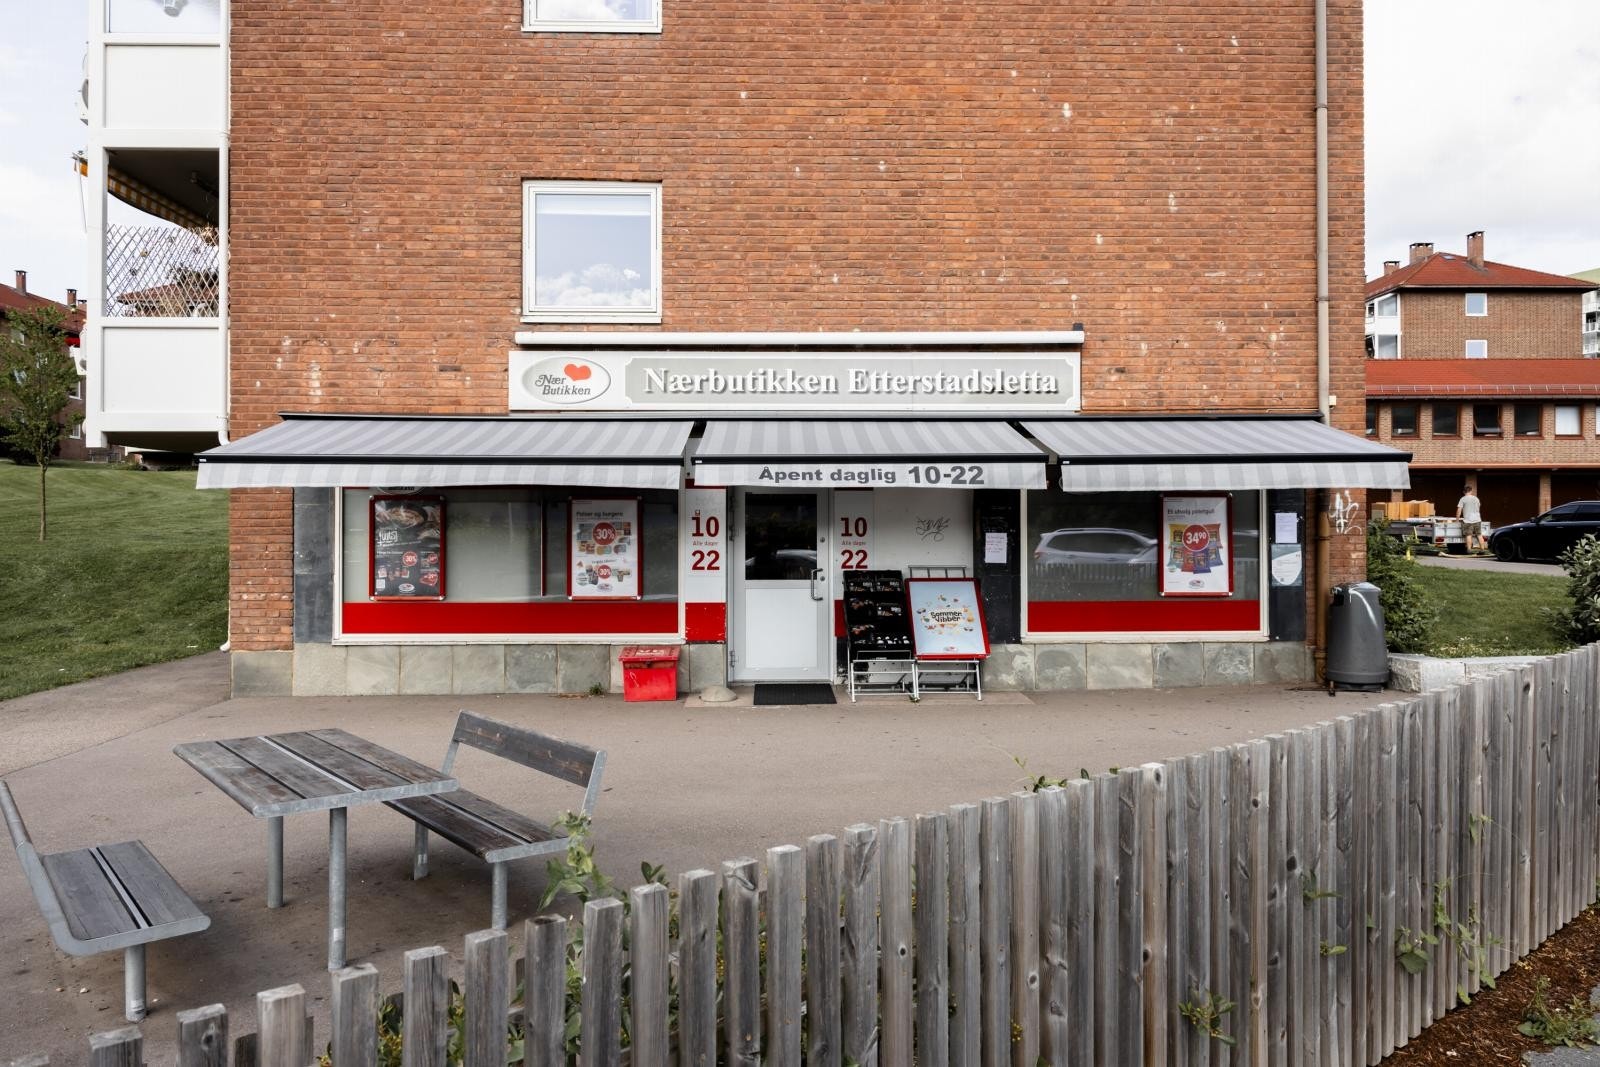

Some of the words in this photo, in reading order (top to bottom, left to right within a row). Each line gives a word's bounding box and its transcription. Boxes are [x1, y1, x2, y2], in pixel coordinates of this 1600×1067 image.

[534, 374, 566, 387] Nær
[542, 385, 591, 396] Butikken
[643, 367, 838, 395] Nærbutikken
[847, 367, 1060, 395] Etterstadsletta
[758, 466, 823, 484] Åpent
[830, 469, 897, 484] daglig
[908, 465, 985, 485] 10-22
[691, 515, 720, 538] 10
[840, 516, 868, 538] 10
[691, 549, 720, 571] 22
[840, 549, 869, 570] 22
